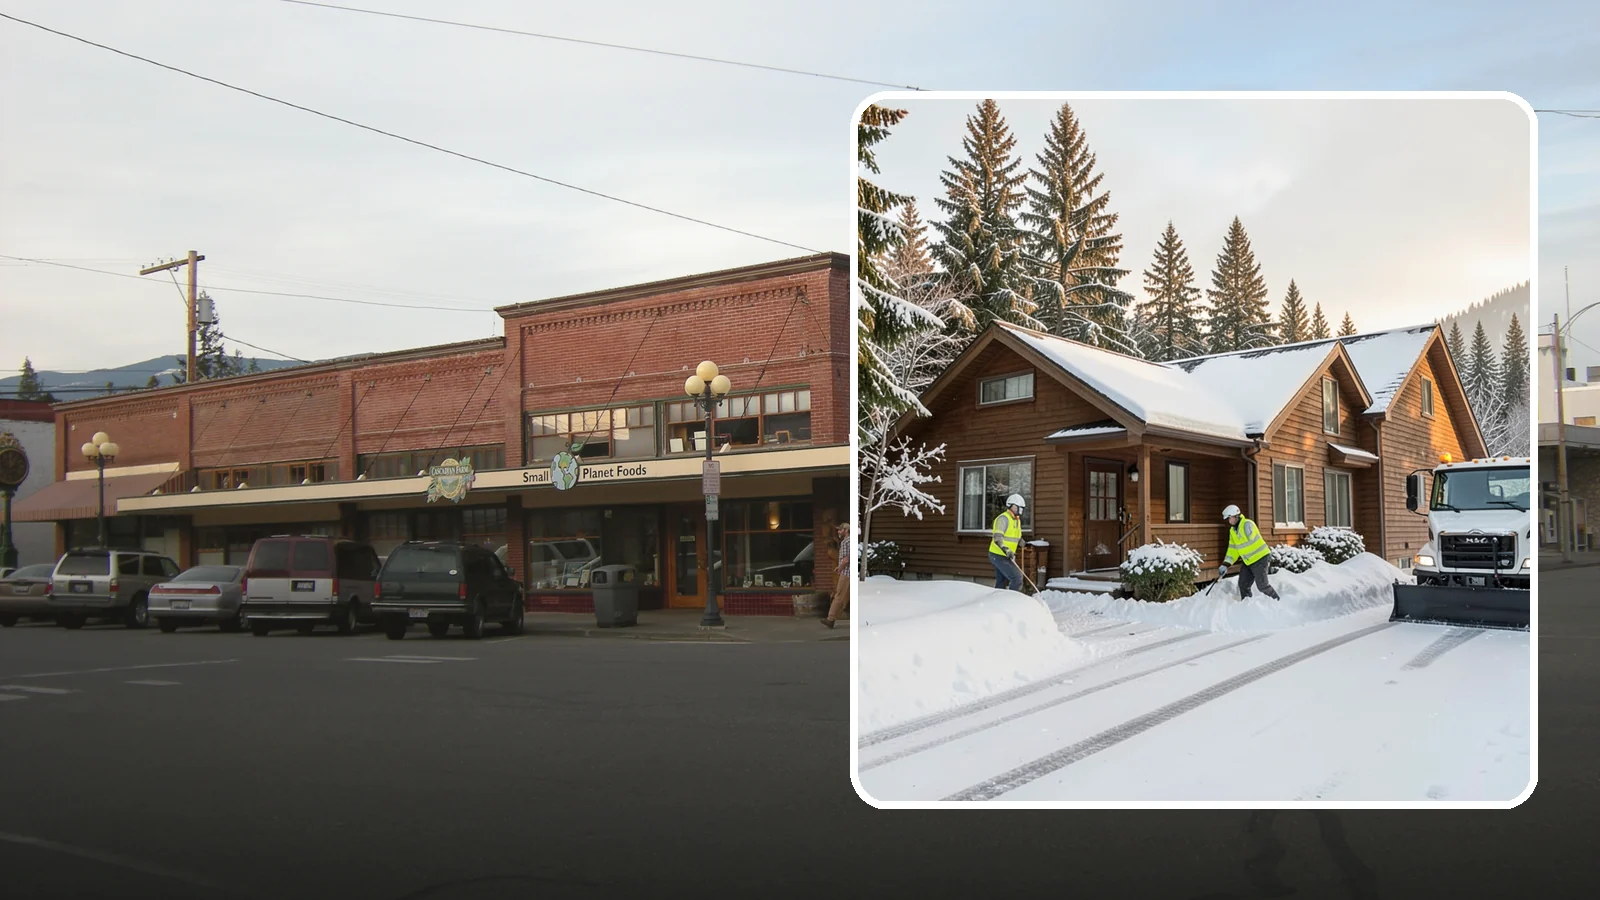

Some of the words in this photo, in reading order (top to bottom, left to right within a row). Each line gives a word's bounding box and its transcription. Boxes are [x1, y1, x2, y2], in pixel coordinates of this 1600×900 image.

[431, 466, 455, 476] CASCADIAN
[523, 471, 549, 483] Small
[583, 468, 614, 479] Planet
[617, 464, 647, 477] Foods
